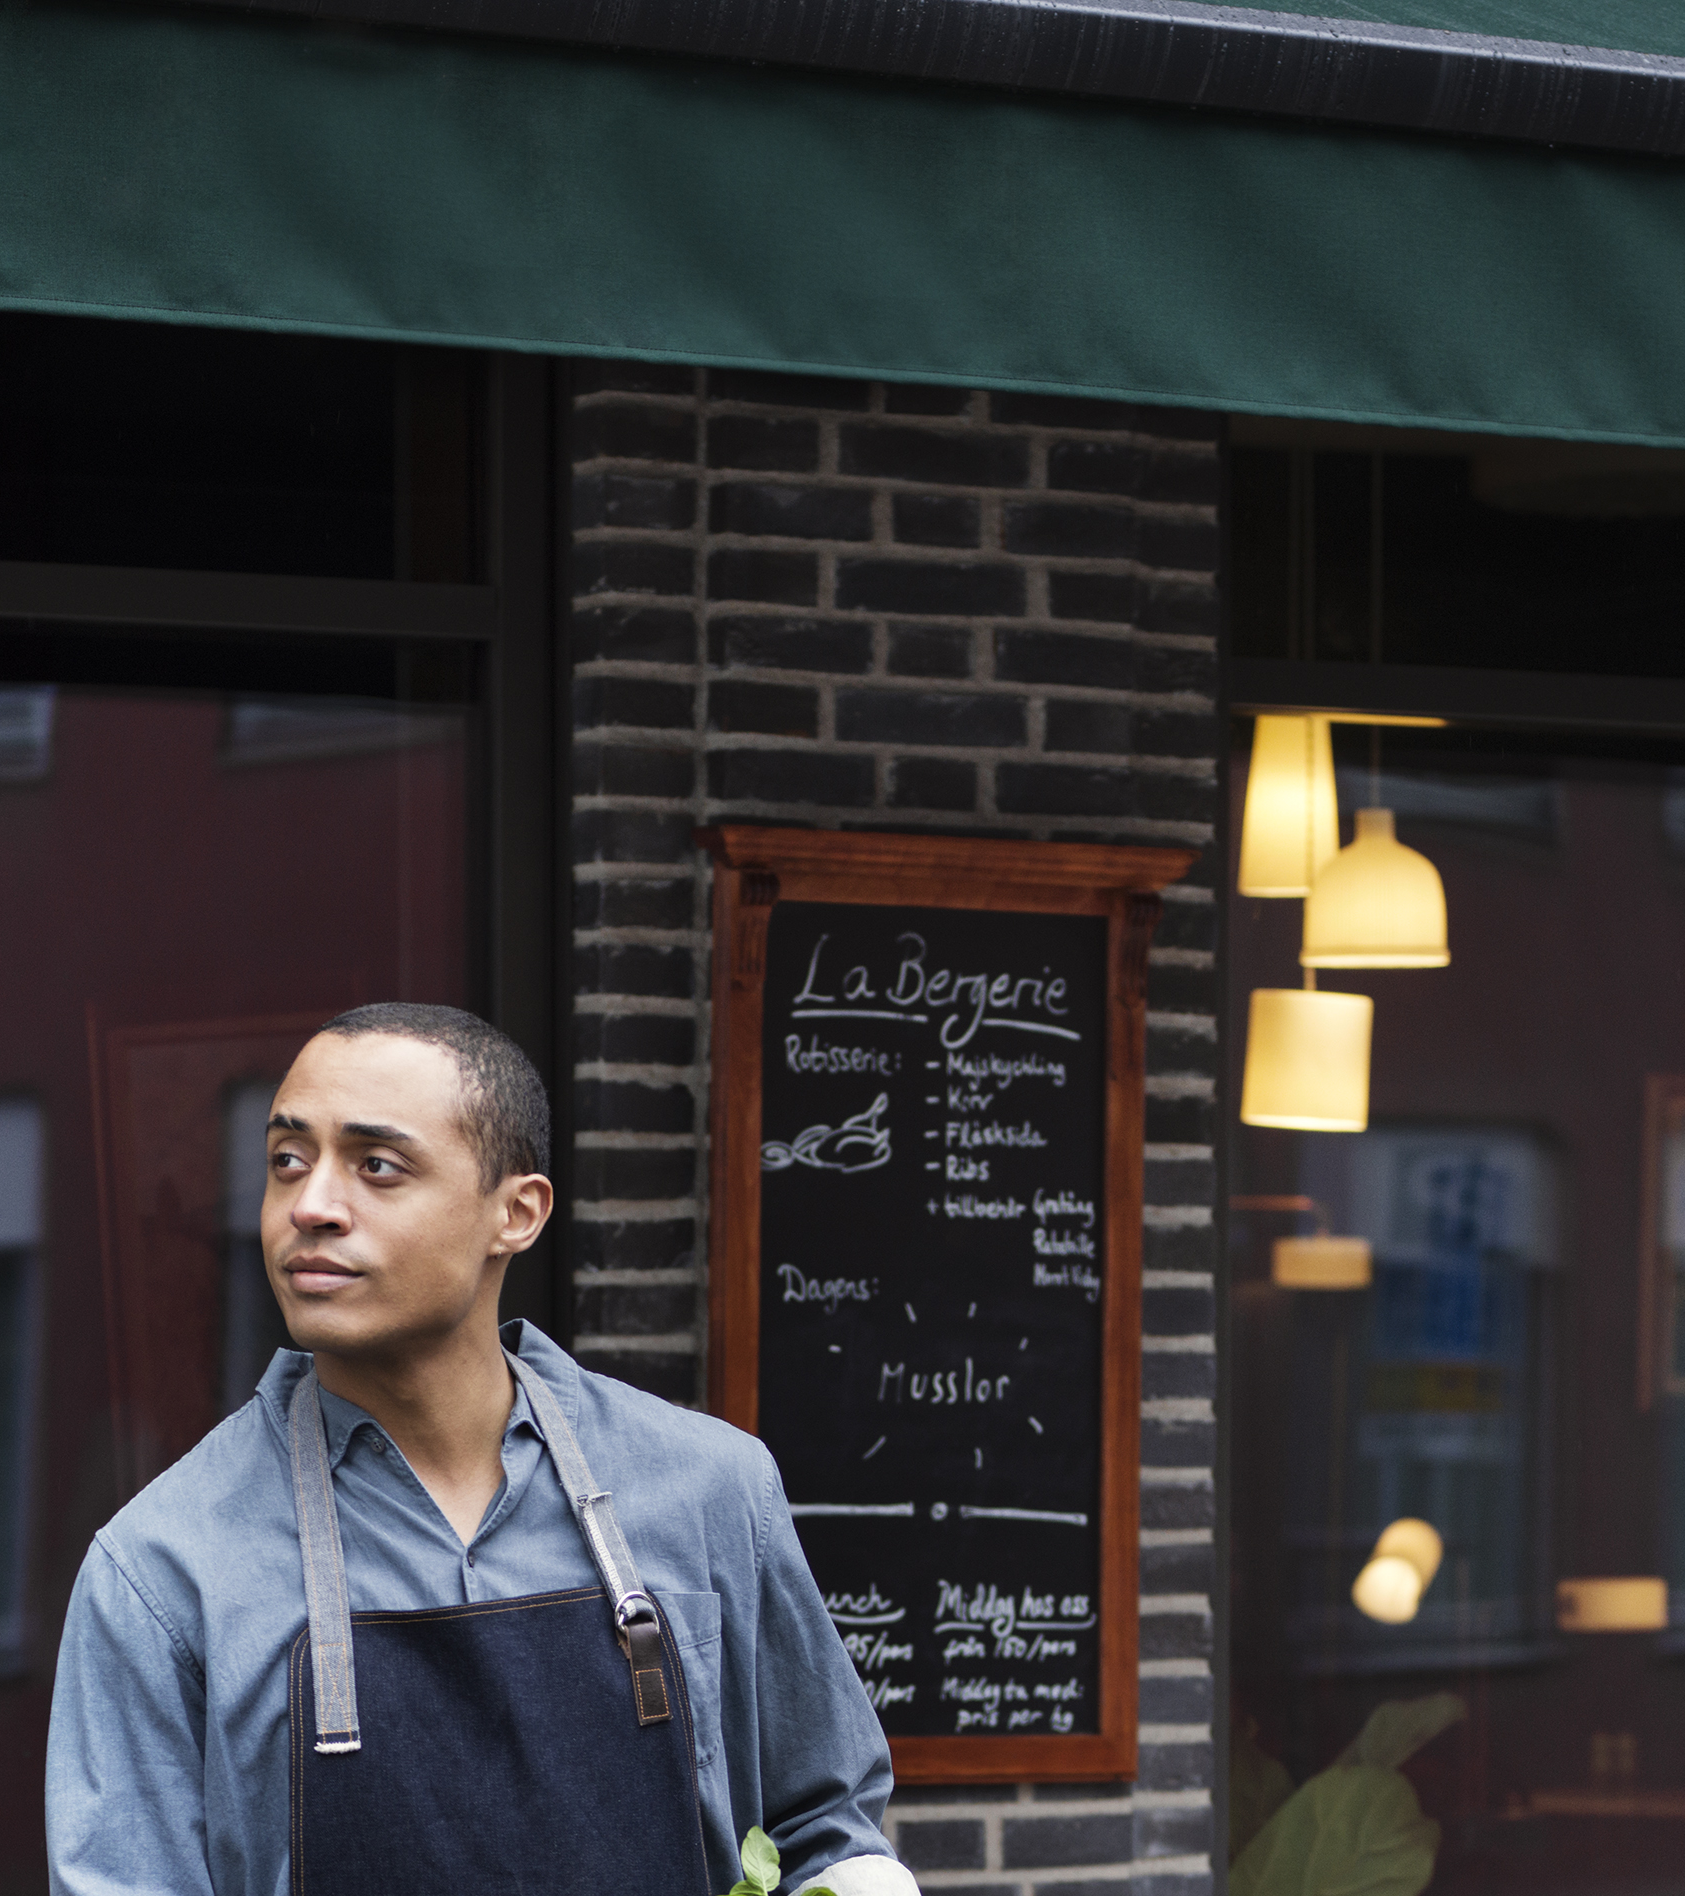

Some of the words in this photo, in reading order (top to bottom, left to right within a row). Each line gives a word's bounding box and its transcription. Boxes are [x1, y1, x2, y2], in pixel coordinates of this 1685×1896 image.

[794, 934, 875, 1004] La
[885, 932, 1069, 1050] Bergerie
[946, 1084, 994, 1113] Korv
[946, 1154, 991, 1183] Ribs
[777, 1264, 881, 1314] Dagens:
[878, 1357, 1011, 1403] Musslor
[820, 1582, 892, 1613] unch
[935, 1578, 1016, 1638] Middag
